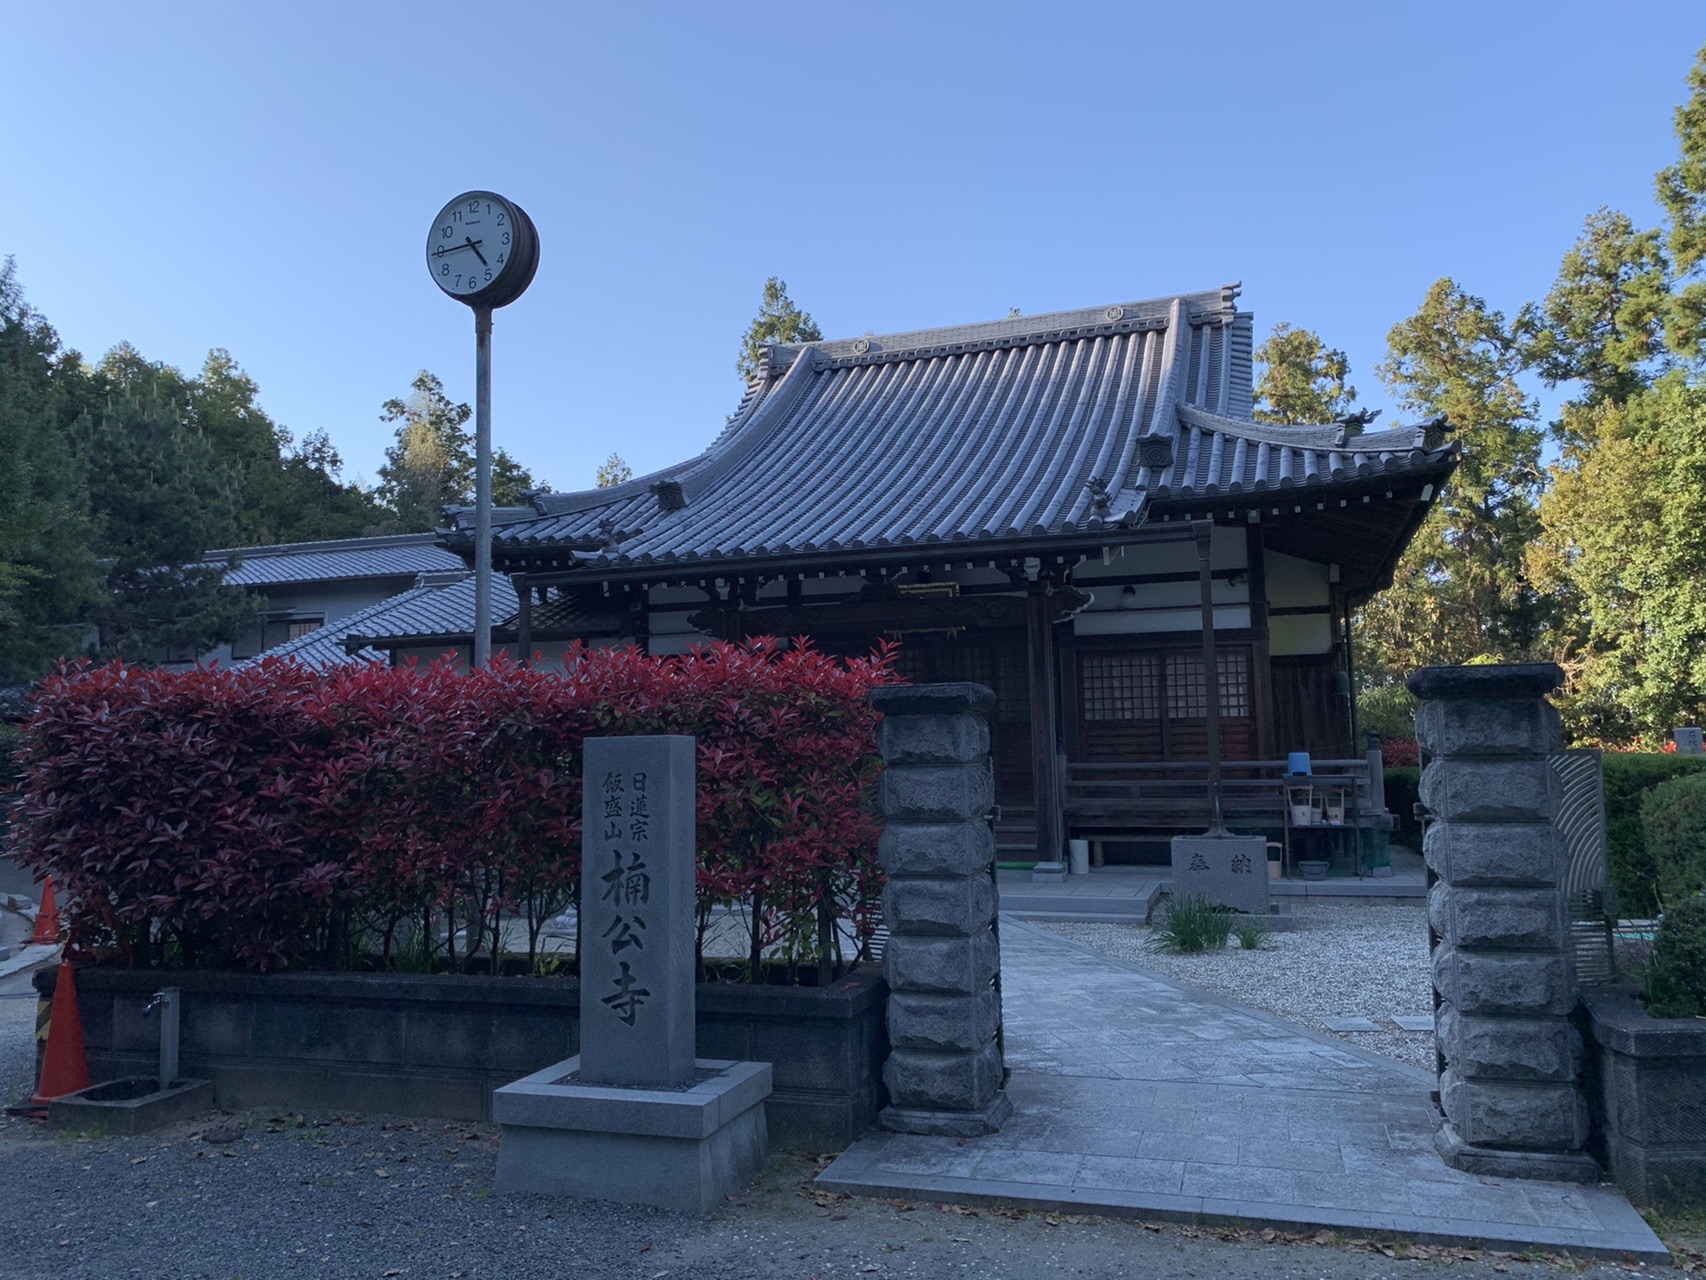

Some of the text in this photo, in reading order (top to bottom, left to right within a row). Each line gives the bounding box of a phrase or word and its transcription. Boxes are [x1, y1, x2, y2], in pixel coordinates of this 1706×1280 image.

[468, 201, 480, 213] 12
[486, 203, 491, 215] 1
[452, 211, 462, 222] 11
[497, 213, 505, 226] 2
[441, 226, 453, 239] 10
[501, 232, 510, 245] 3
[437, 245, 445, 258] 9
[496, 253, 504, 264] 4
[441, 263, 450, 276] 8
[484, 268, 492, 281] 5
[455, 274, 462, 287] 7
[468, 276, 477, 289] 6
[601, 771, 625, 841] 飯盛山
[629, 772, 650, 842] 日蓮宗
[1188, 852, 1252, 874] 奉納
[600, 849, 651, 1027] 楠公寺
